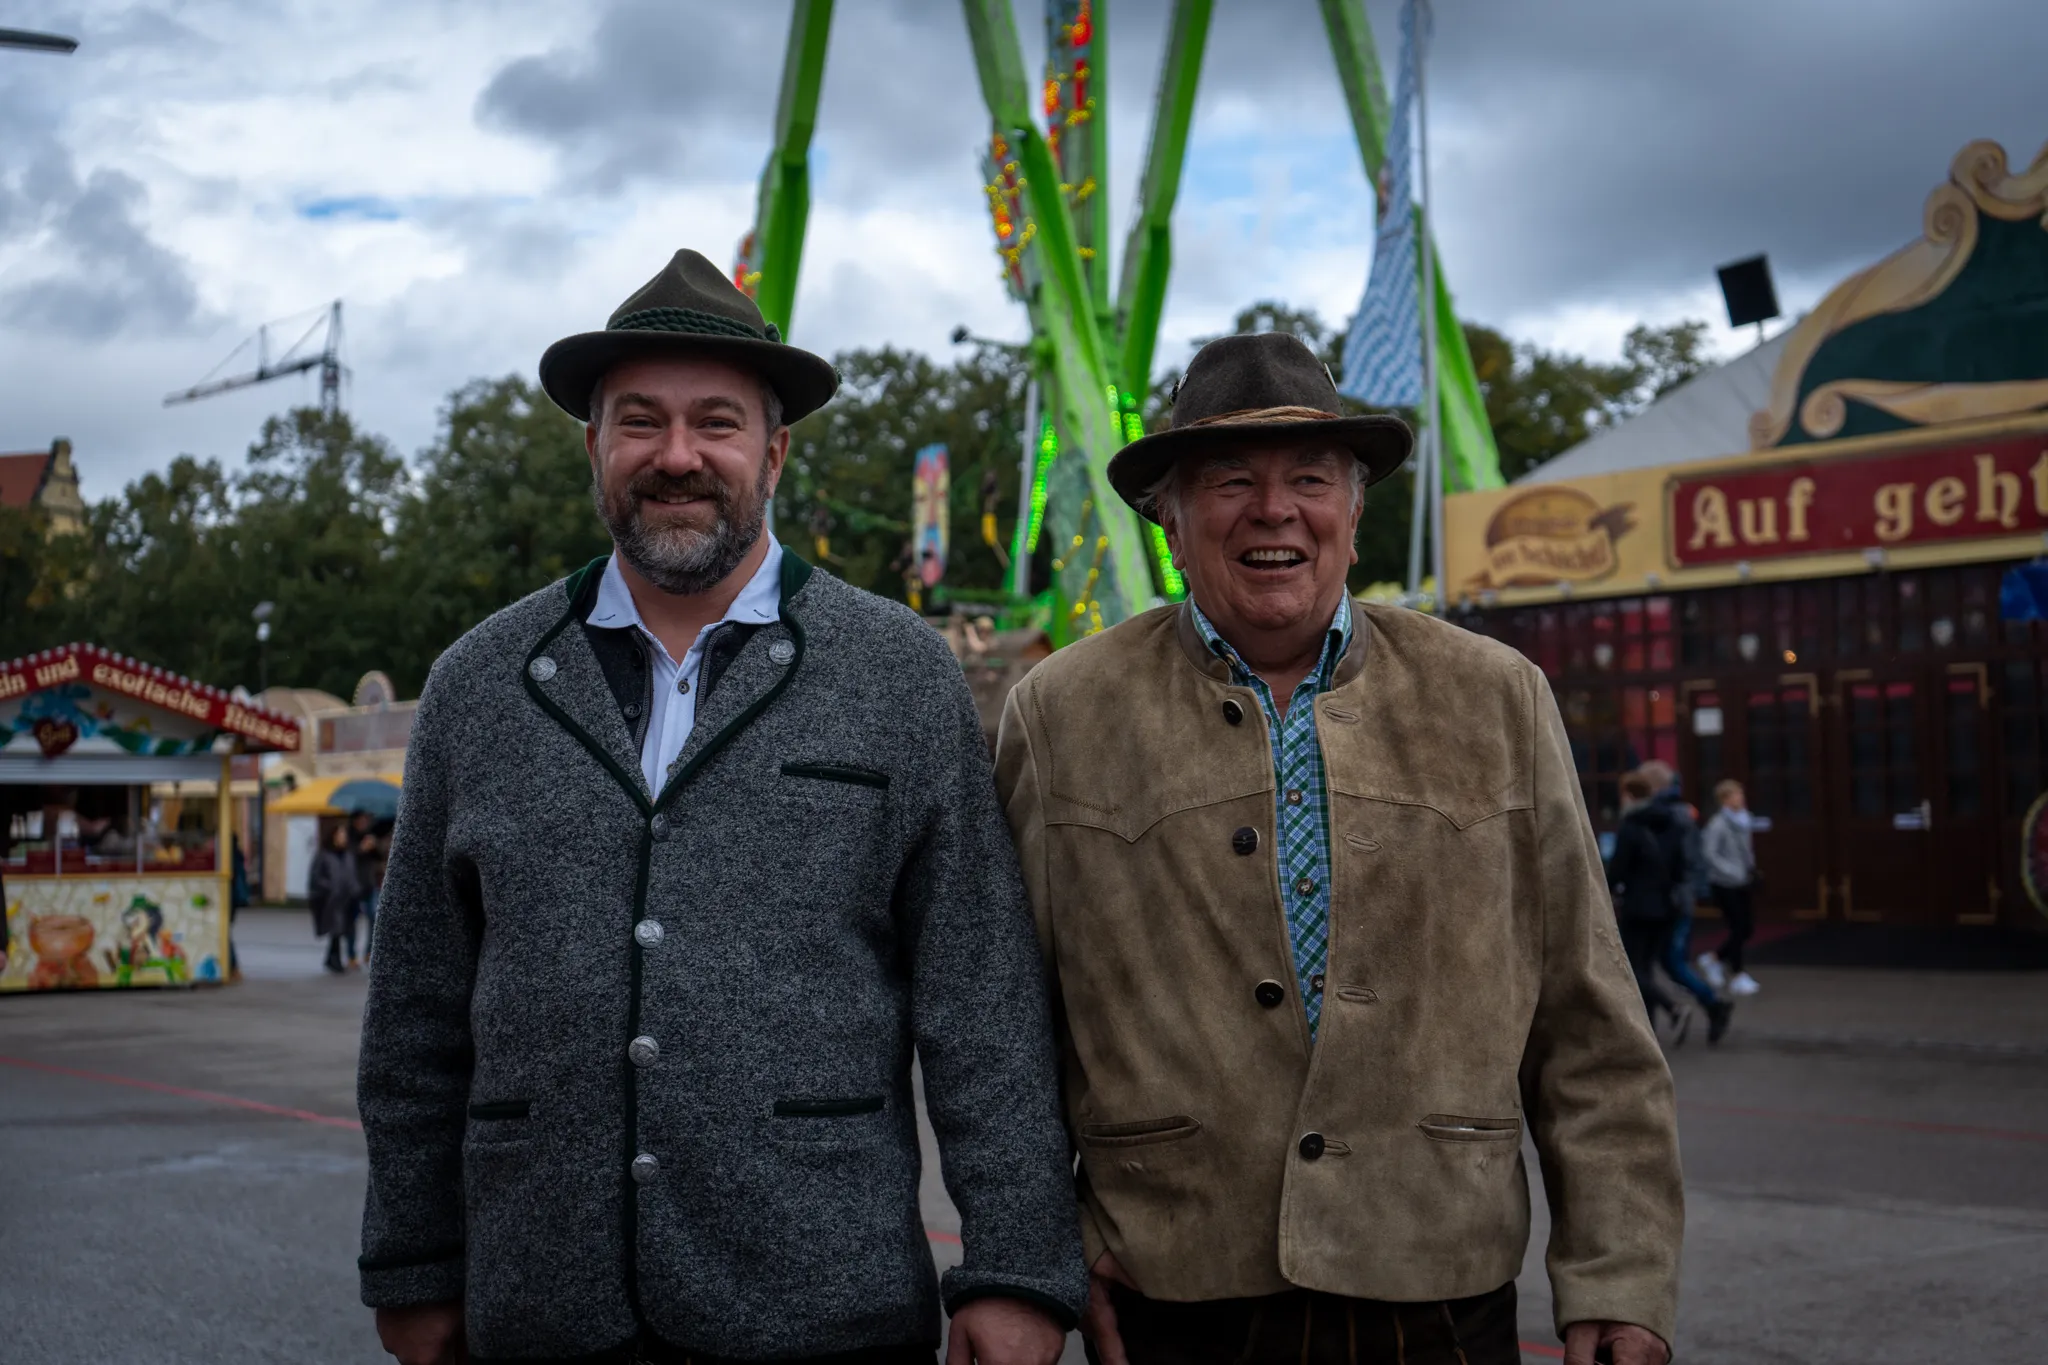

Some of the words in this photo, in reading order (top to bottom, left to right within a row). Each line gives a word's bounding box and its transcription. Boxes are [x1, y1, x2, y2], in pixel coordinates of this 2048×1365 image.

[1688, 477, 1816, 551] Auf
[34, 654, 80, 687] und
[93, 664, 209, 719] exotische
